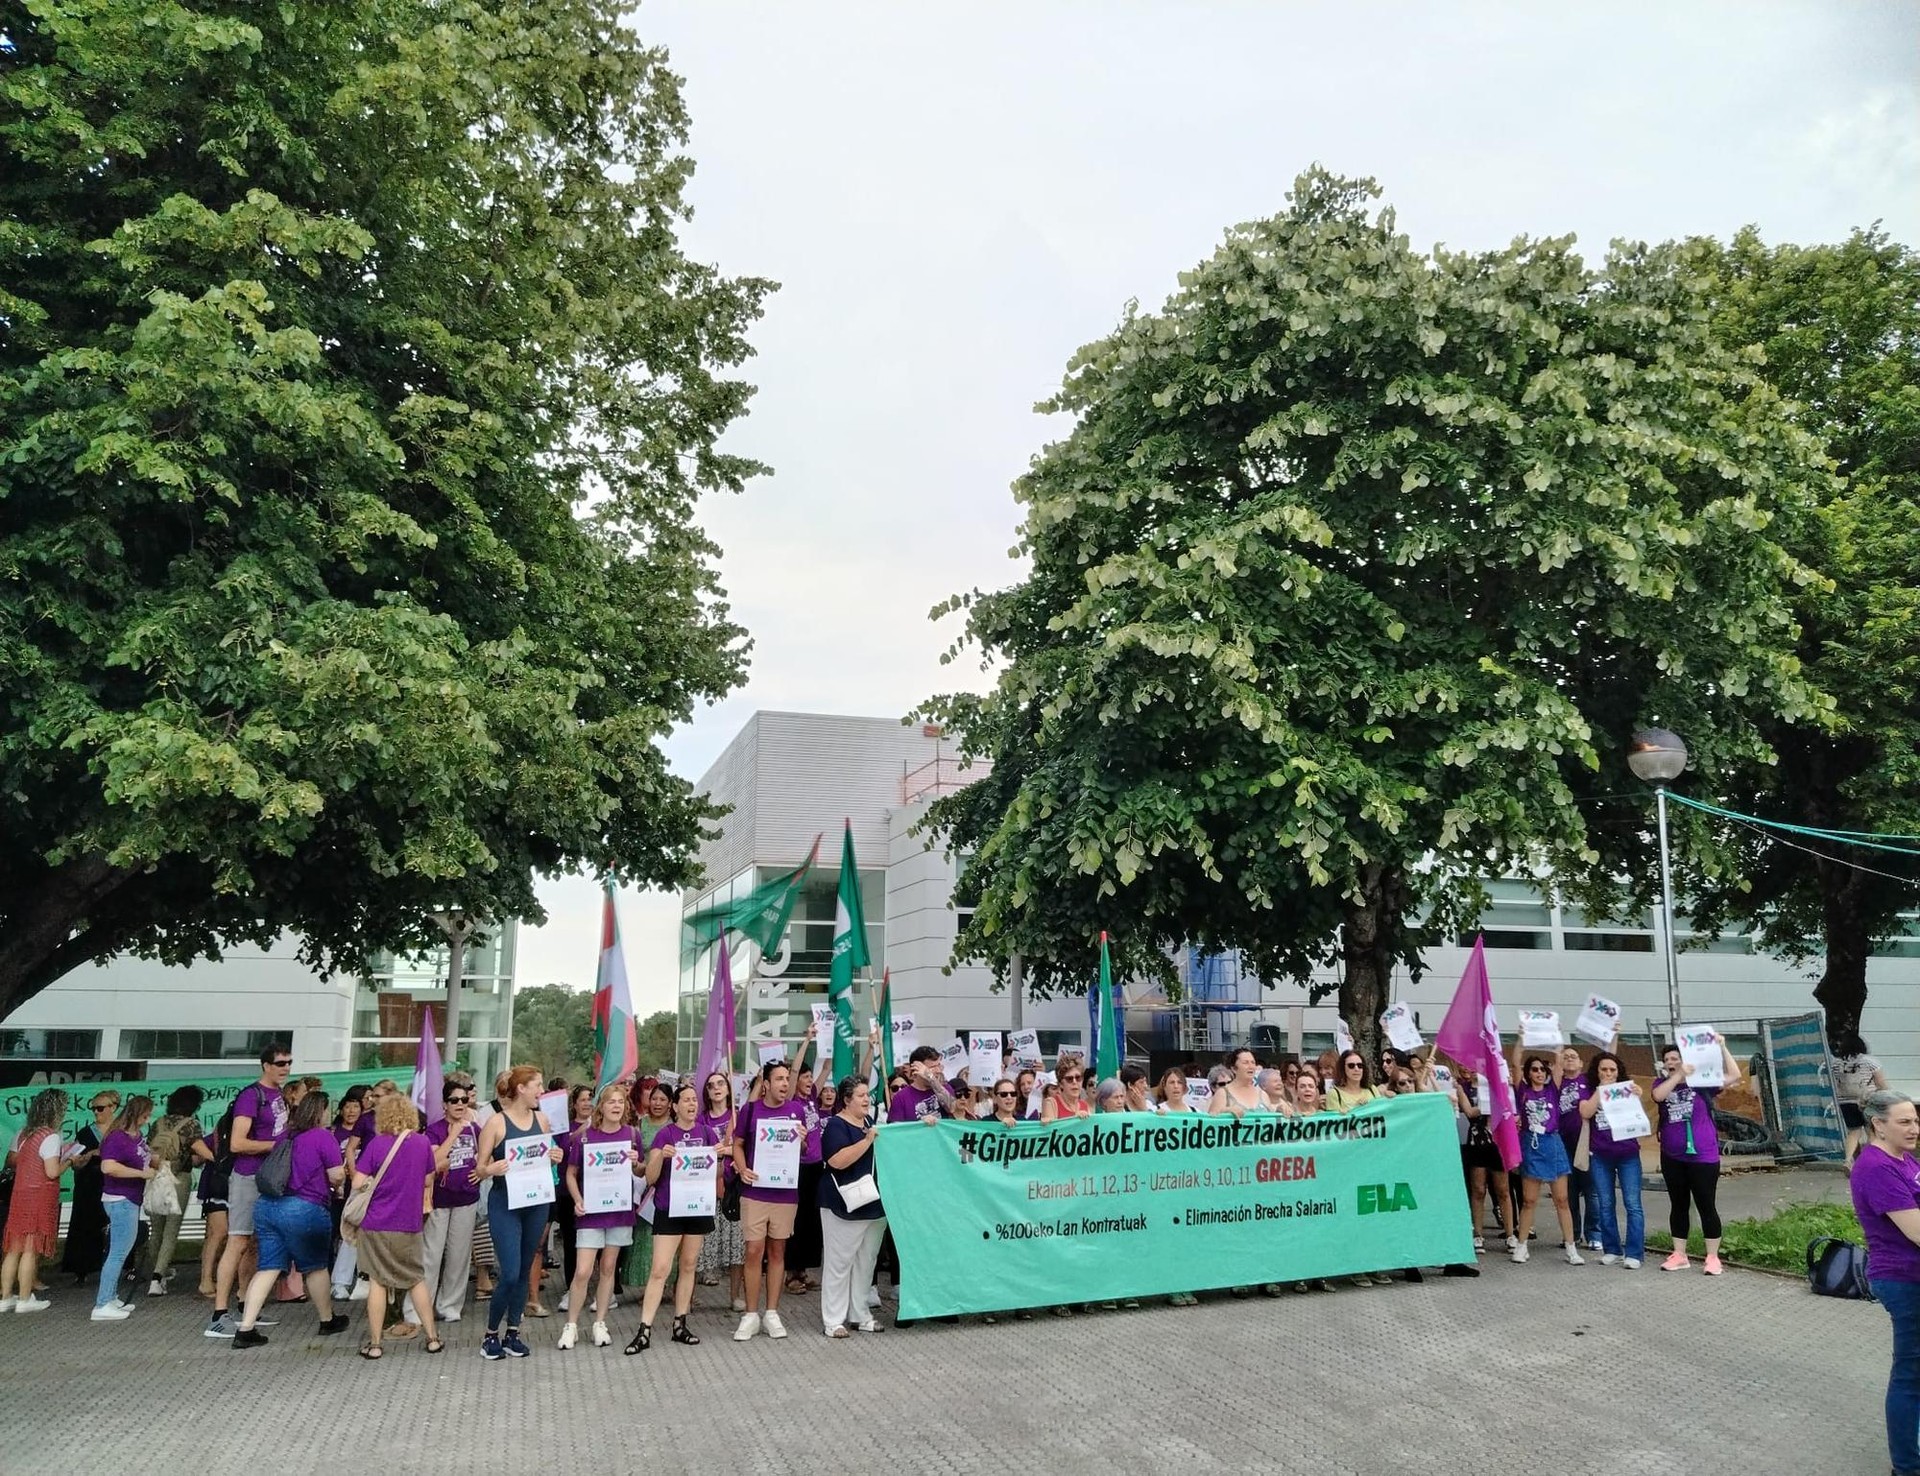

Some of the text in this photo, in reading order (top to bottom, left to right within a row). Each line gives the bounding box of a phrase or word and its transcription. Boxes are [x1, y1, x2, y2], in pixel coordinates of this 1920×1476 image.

[959, 1115, 1386, 1168] #GipuzkoakoErresidentziakBorrokan
[1028, 1181, 1078, 1200] Ekainak
[1082, 1177, 1099, 1198] 11,
[1102, 1175, 1121, 1196] 12,
[1123, 1174, 1138, 1193] 13
[1150, 1169, 1200, 1191] Uztailak
[1203, 1168, 1215, 1188] 9,
[1217, 1167, 1236, 1187] 10,
[1238, 1166, 1251, 1185] 11
[1256, 1156, 1317, 1183] GREBA
[1186, 1198, 1337, 1226] Eliminación Brecha Salarial
[1357, 1182, 1417, 1216] ELA
[996, 1213, 1147, 1241] %100eko Lan Kontratuak
